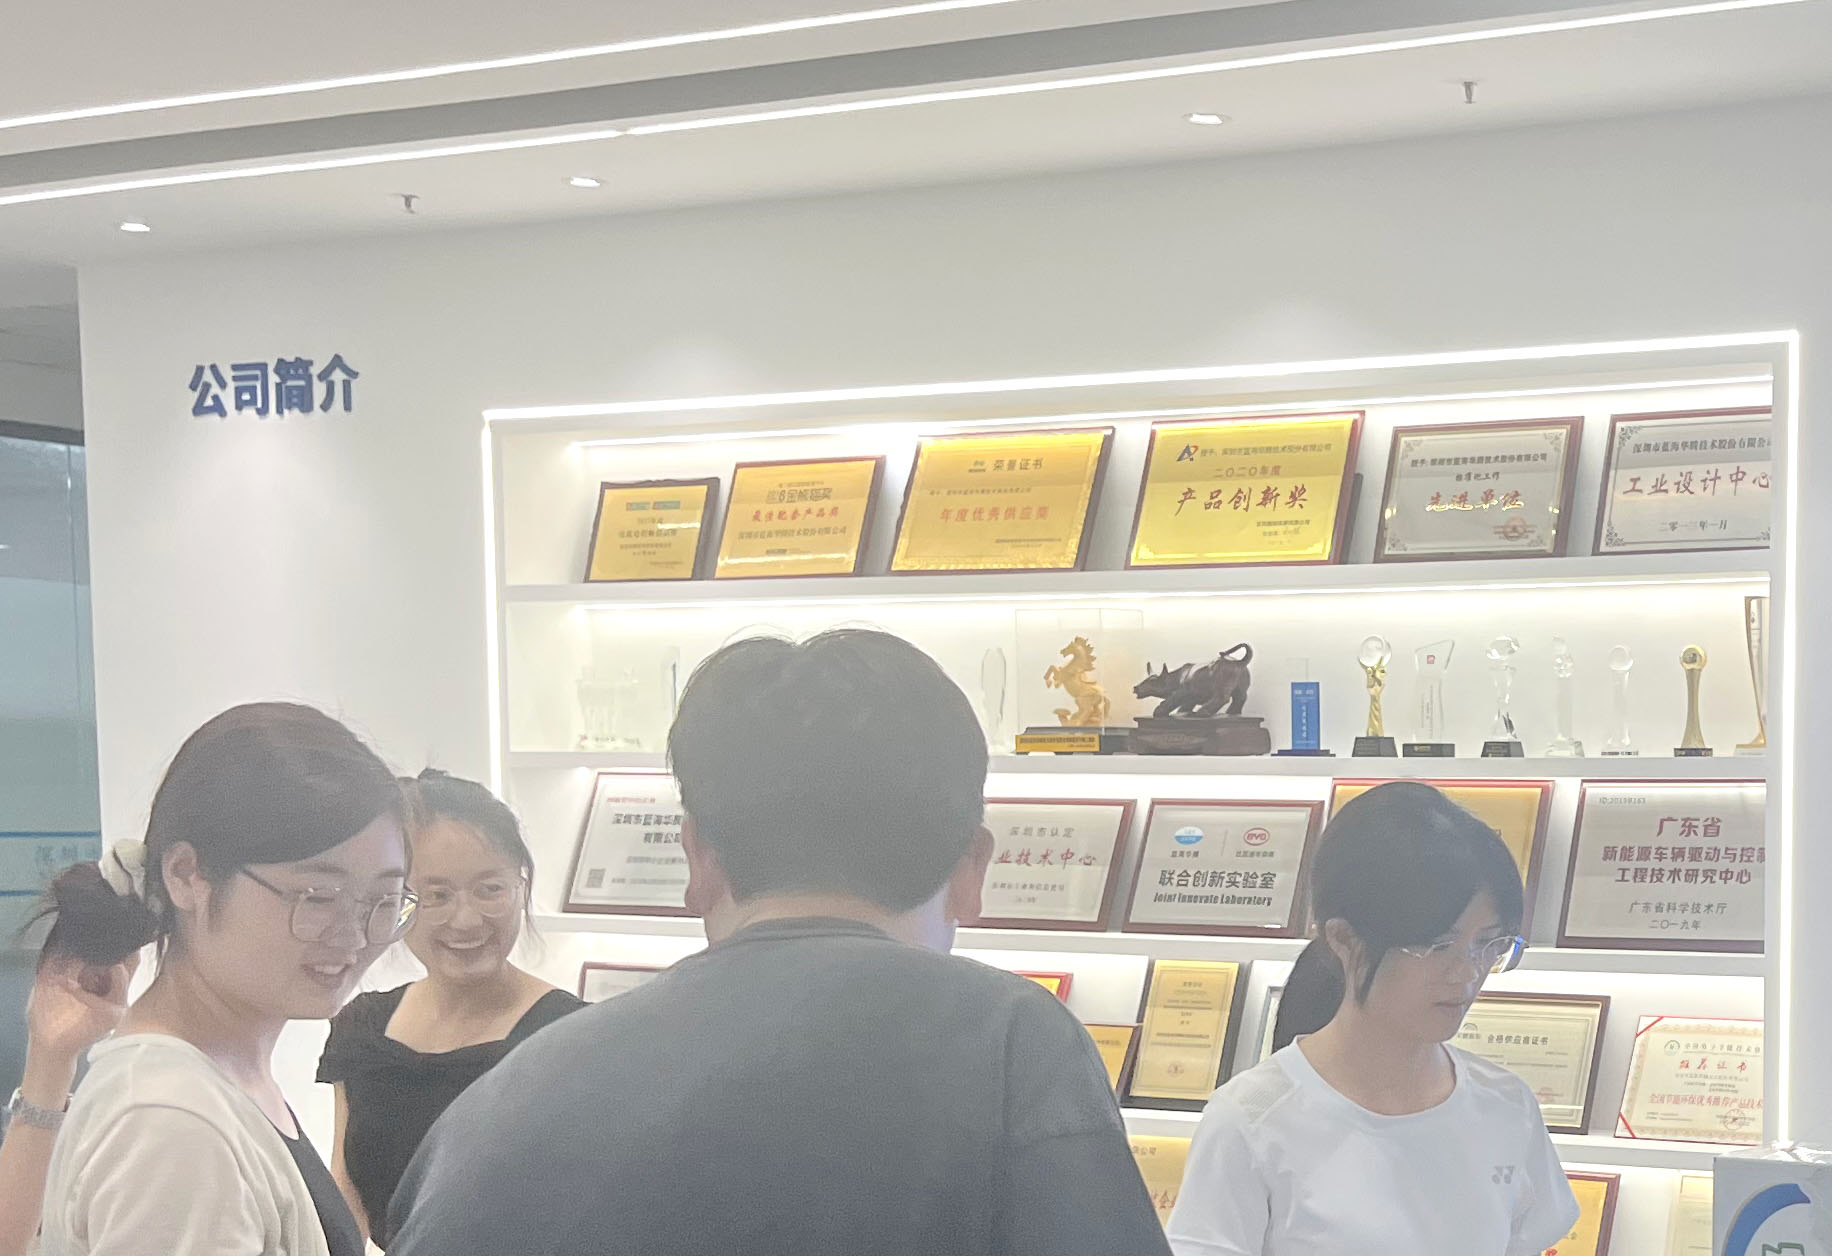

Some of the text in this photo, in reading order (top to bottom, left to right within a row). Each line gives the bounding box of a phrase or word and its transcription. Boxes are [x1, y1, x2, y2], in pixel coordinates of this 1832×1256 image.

[189, 353, 359, 417] 公司简介
[1622, 465, 1772, 497] 工业设计中心
[1174, 484, 1309, 517] 产品创新奖
[1656, 816, 1723, 838] 广东省
[1158, 869, 1277, 890] 联合创新实验室
[1615, 867, 1752, 885] 工程技术研究中心
